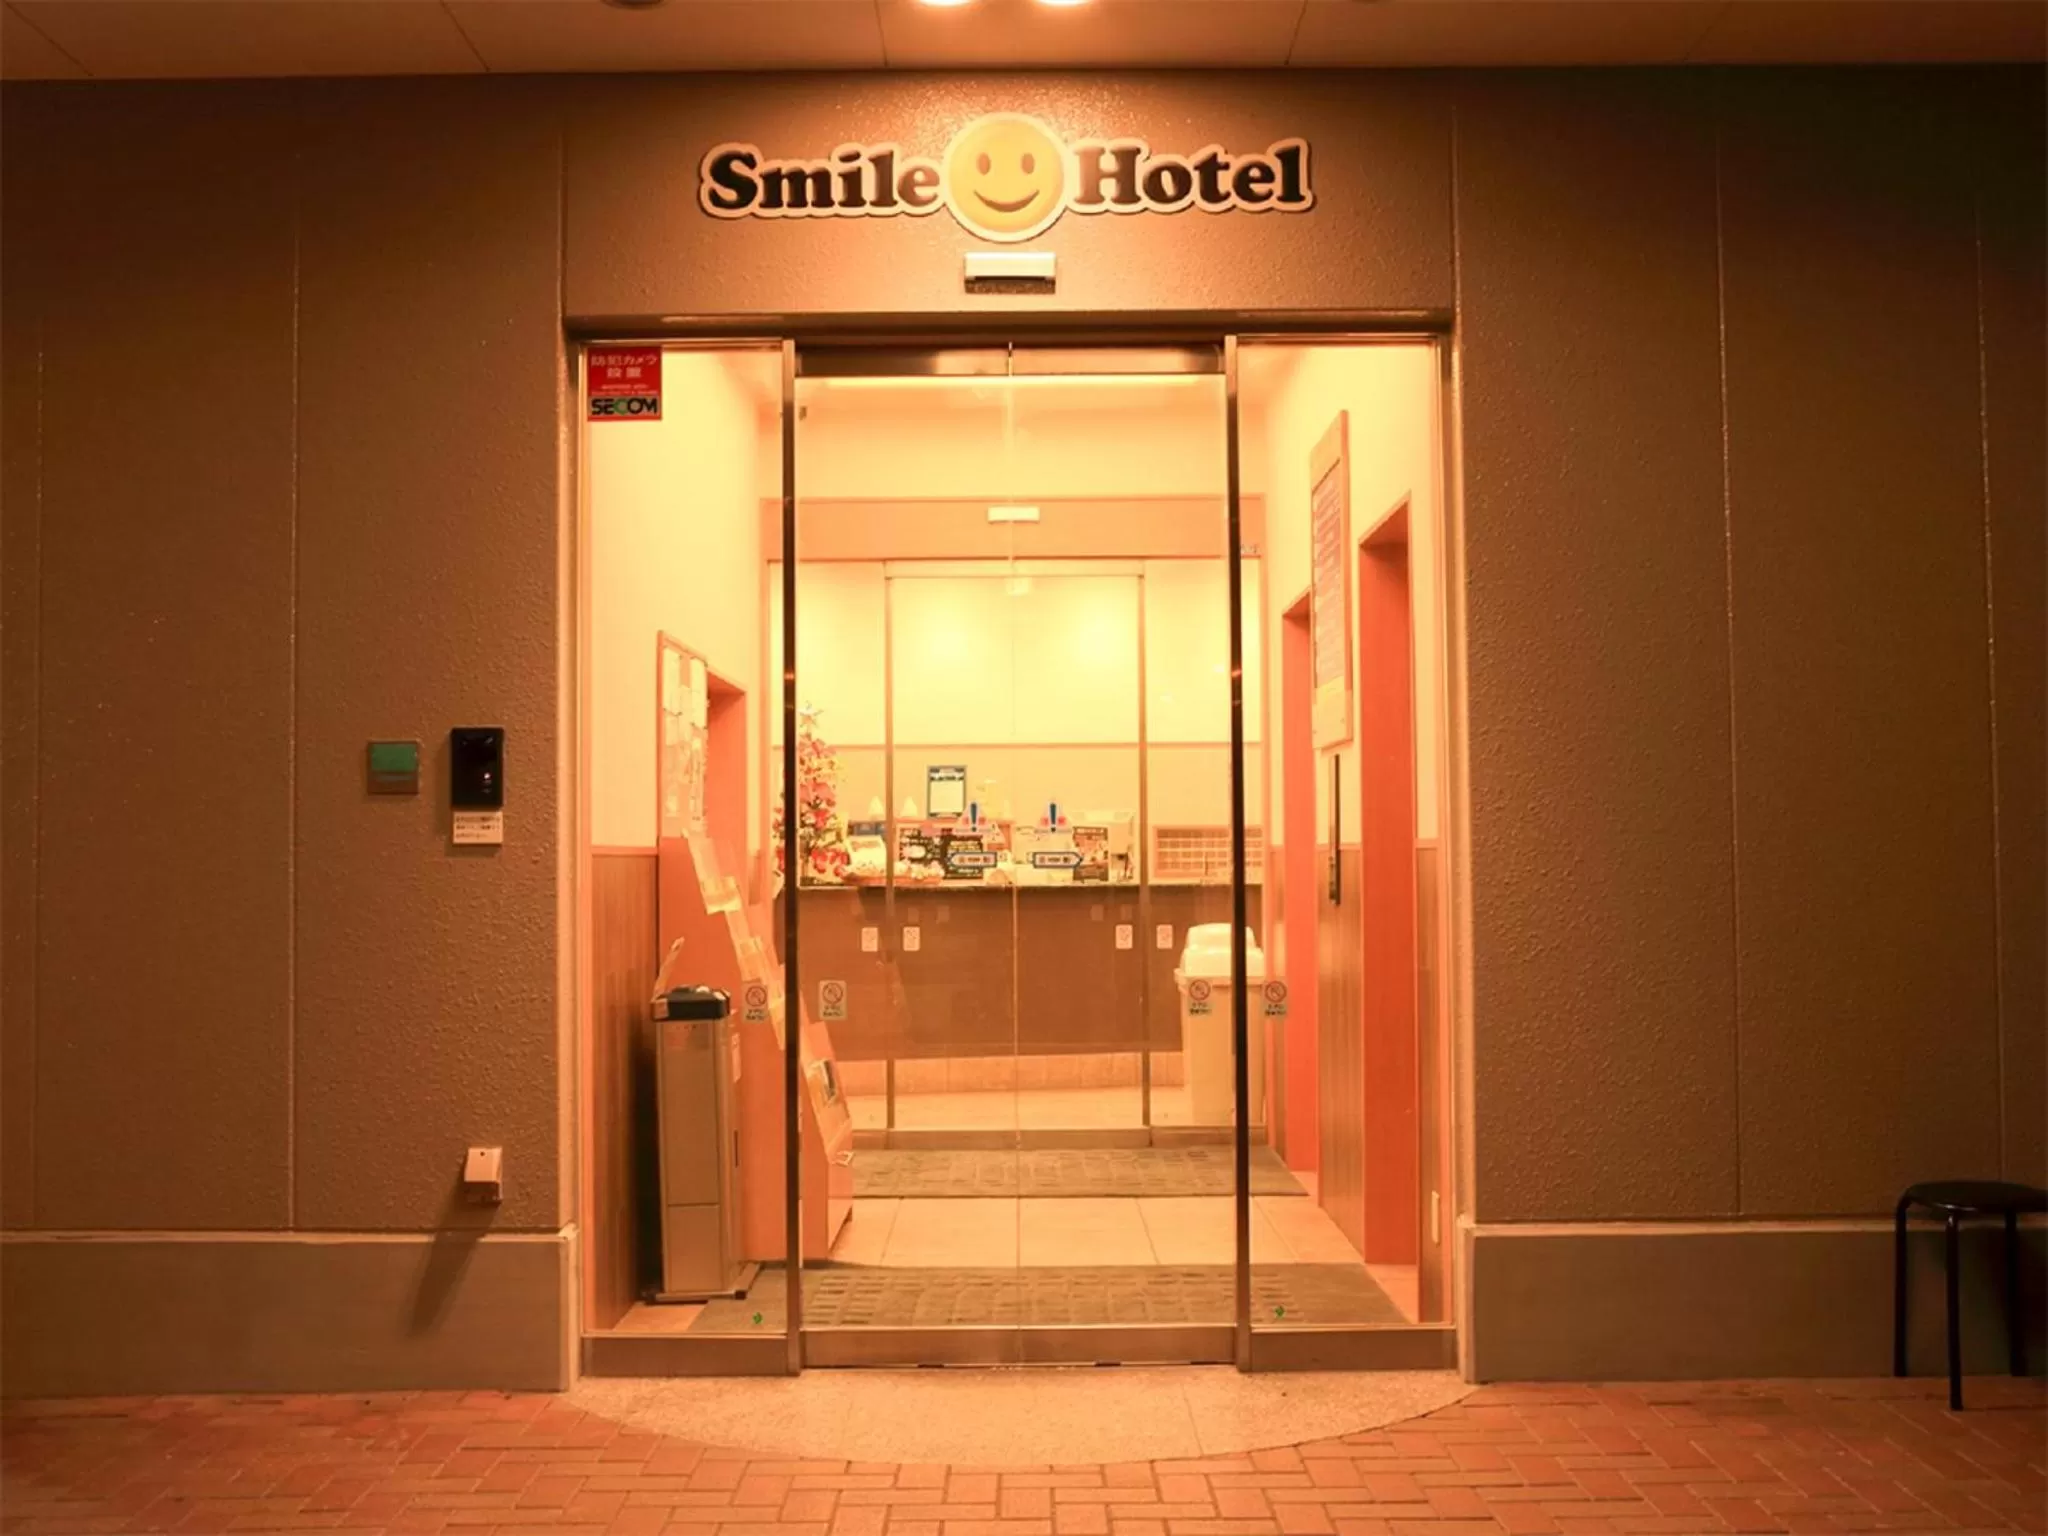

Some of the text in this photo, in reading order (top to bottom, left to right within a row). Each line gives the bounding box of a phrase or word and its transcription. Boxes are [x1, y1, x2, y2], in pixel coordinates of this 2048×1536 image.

[708, 145, 1306, 209] Smile Hotel
[591, 398, 658, 416] SECOM
